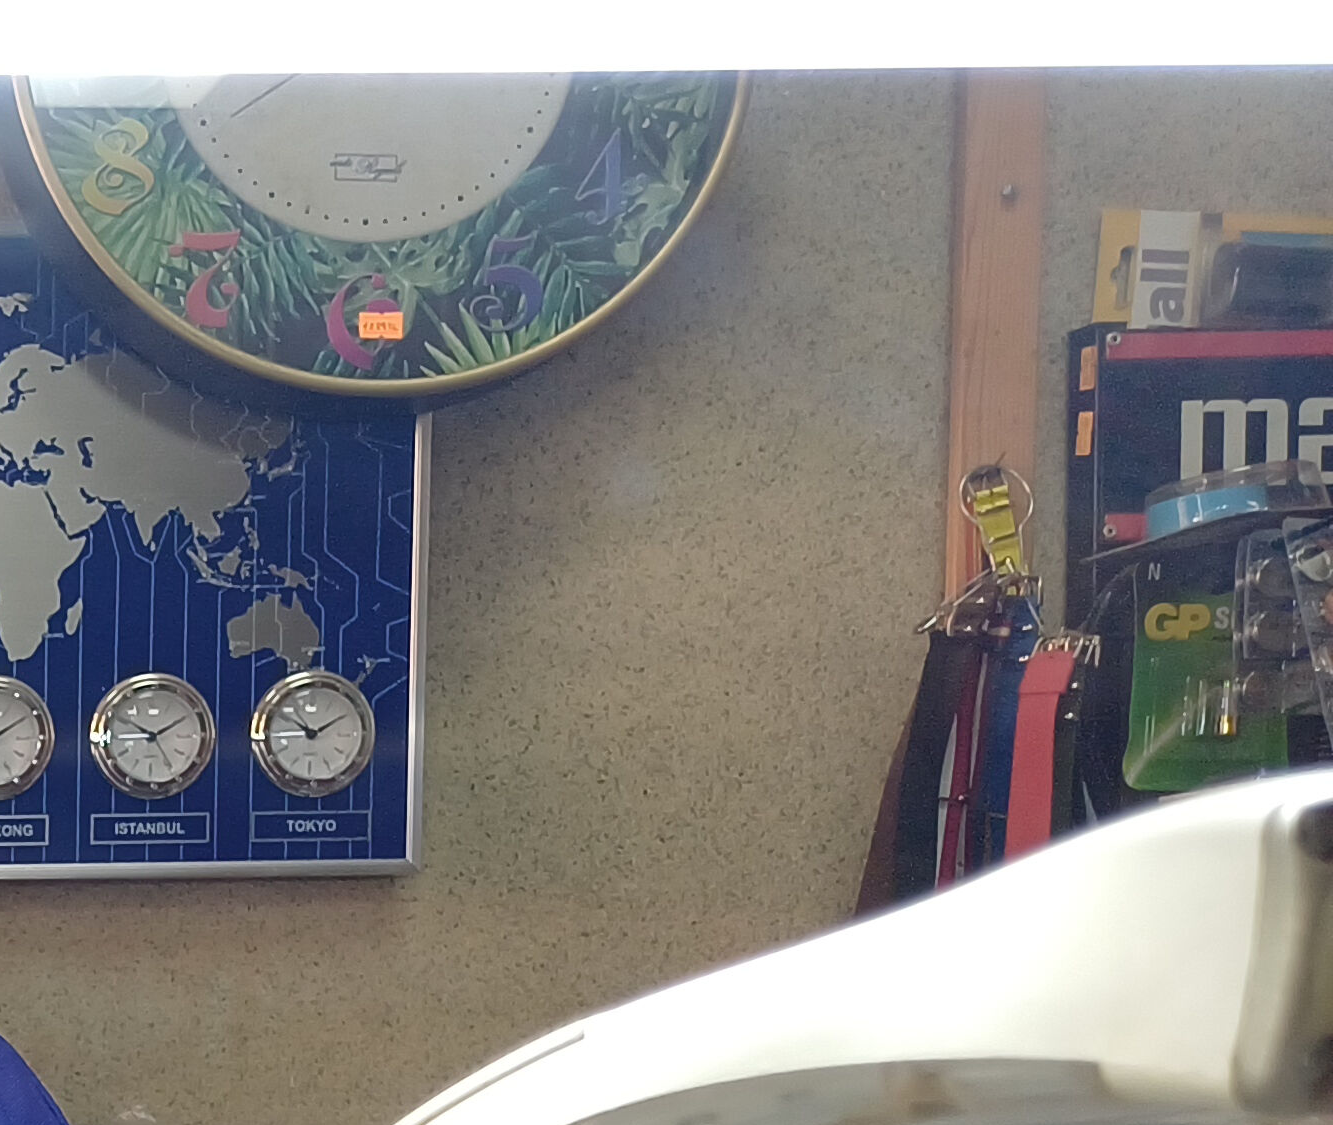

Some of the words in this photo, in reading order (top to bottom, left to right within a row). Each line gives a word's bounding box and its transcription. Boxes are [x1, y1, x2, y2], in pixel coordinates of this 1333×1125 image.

[81, 118, 155, 217] 8
[575, 128, 622, 225] 4
[169, 230, 241, 329] 7
[470, 235, 543, 333] 5
[1148, 562, 1161, 581] N
[1144, 603, 1212, 641] GP
[114, 822, 185, 835] ISTANBUL
[286, 819, 337, 832] TOKYO
